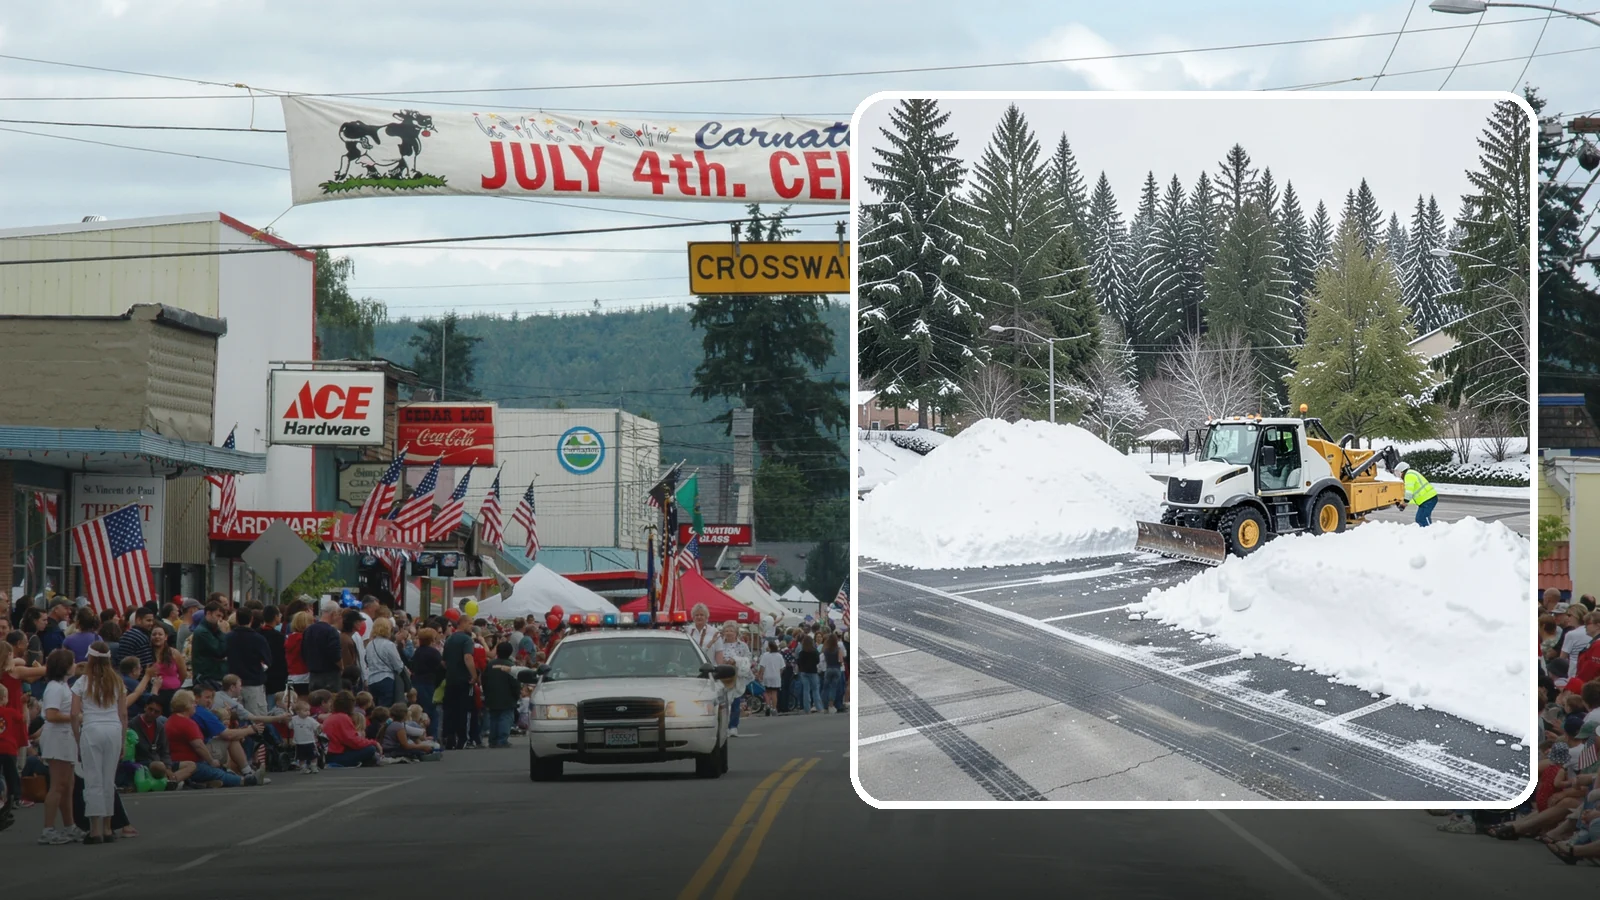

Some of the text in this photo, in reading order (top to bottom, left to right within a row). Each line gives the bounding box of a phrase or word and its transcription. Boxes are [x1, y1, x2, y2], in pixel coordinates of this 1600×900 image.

[695, 121, 850, 150] Carnat
[481, 140, 605, 193] JULY
[632, 149, 746, 198] 4th.
[697, 254, 850, 280] CROSSWA
[282, 379, 374, 420] ACE
[406, 409, 453, 422] CEDAR
[283, 420, 371, 437] Hardware
[96, 484, 124, 495] Vincent
[126, 486, 136, 495] de
[137, 486, 155, 495] Paul
[81, 503, 154, 522] THT
[688, 526, 742, 535] CRNATION
[699, 535, 730, 544] GLASS
